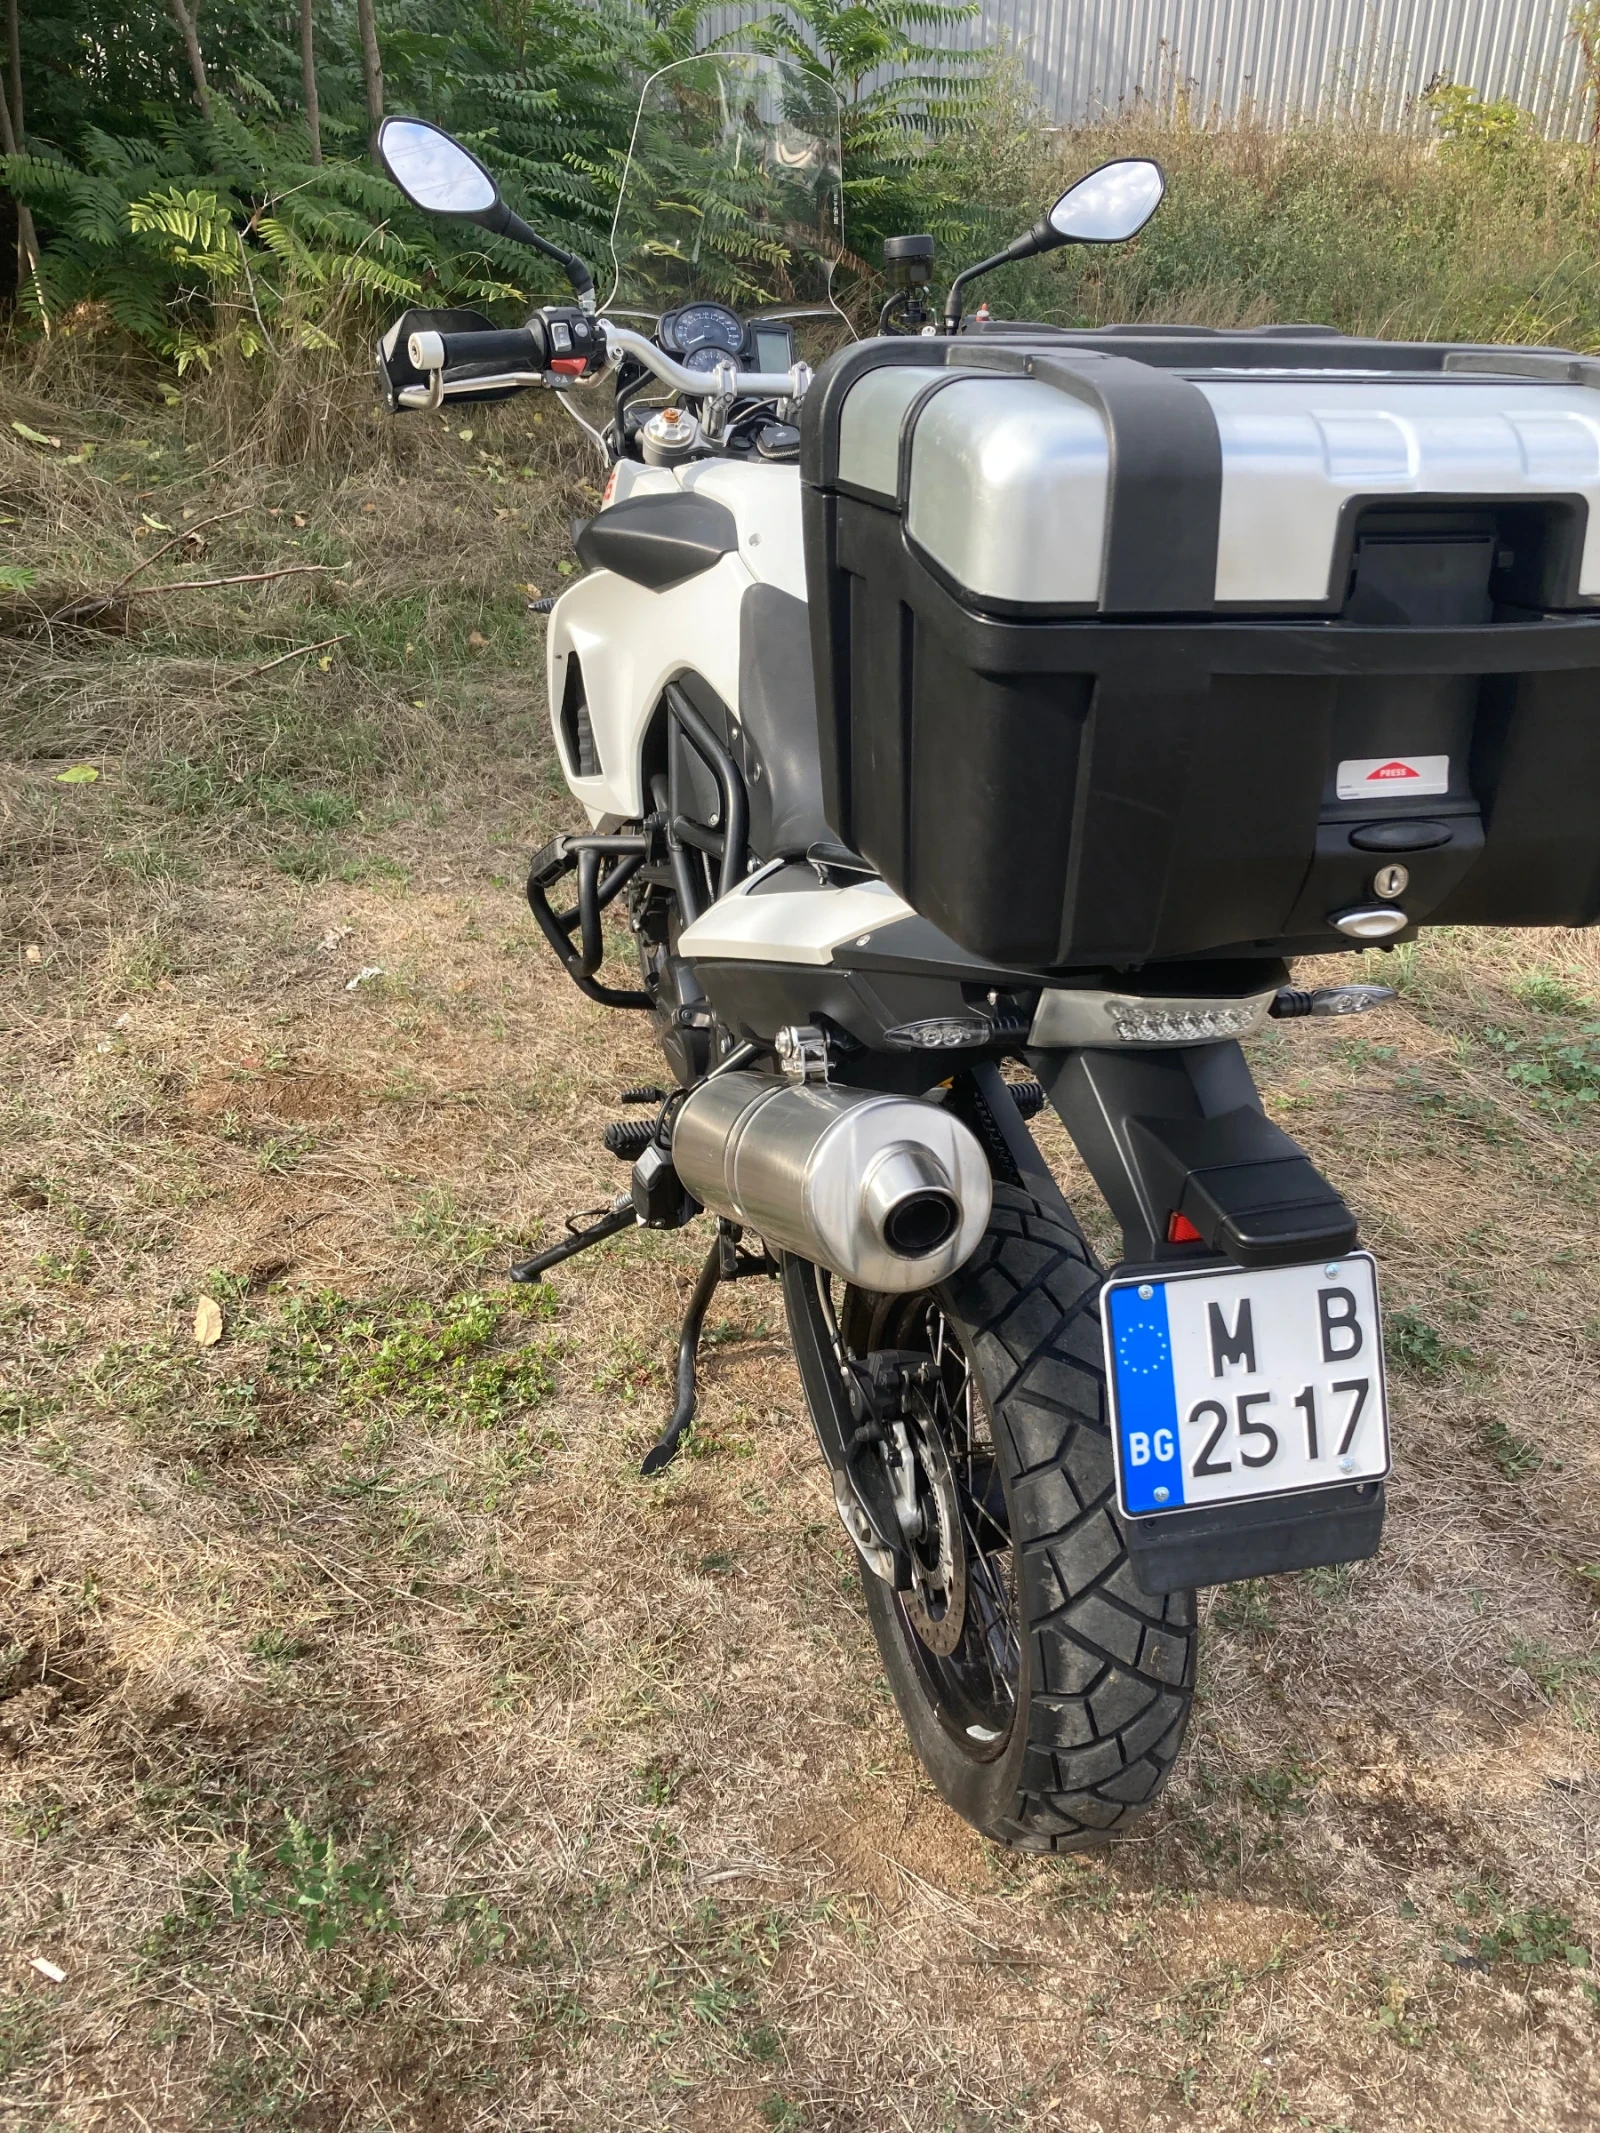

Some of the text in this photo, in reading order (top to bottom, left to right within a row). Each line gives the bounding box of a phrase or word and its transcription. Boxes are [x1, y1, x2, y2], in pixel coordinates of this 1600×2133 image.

[1380, 768, 1407, 777] PRESS
[1207, 1286, 1363, 1377] M B
[1129, 1429, 1175, 1466] BG
[1189, 1378, 1369, 1477] 2517
